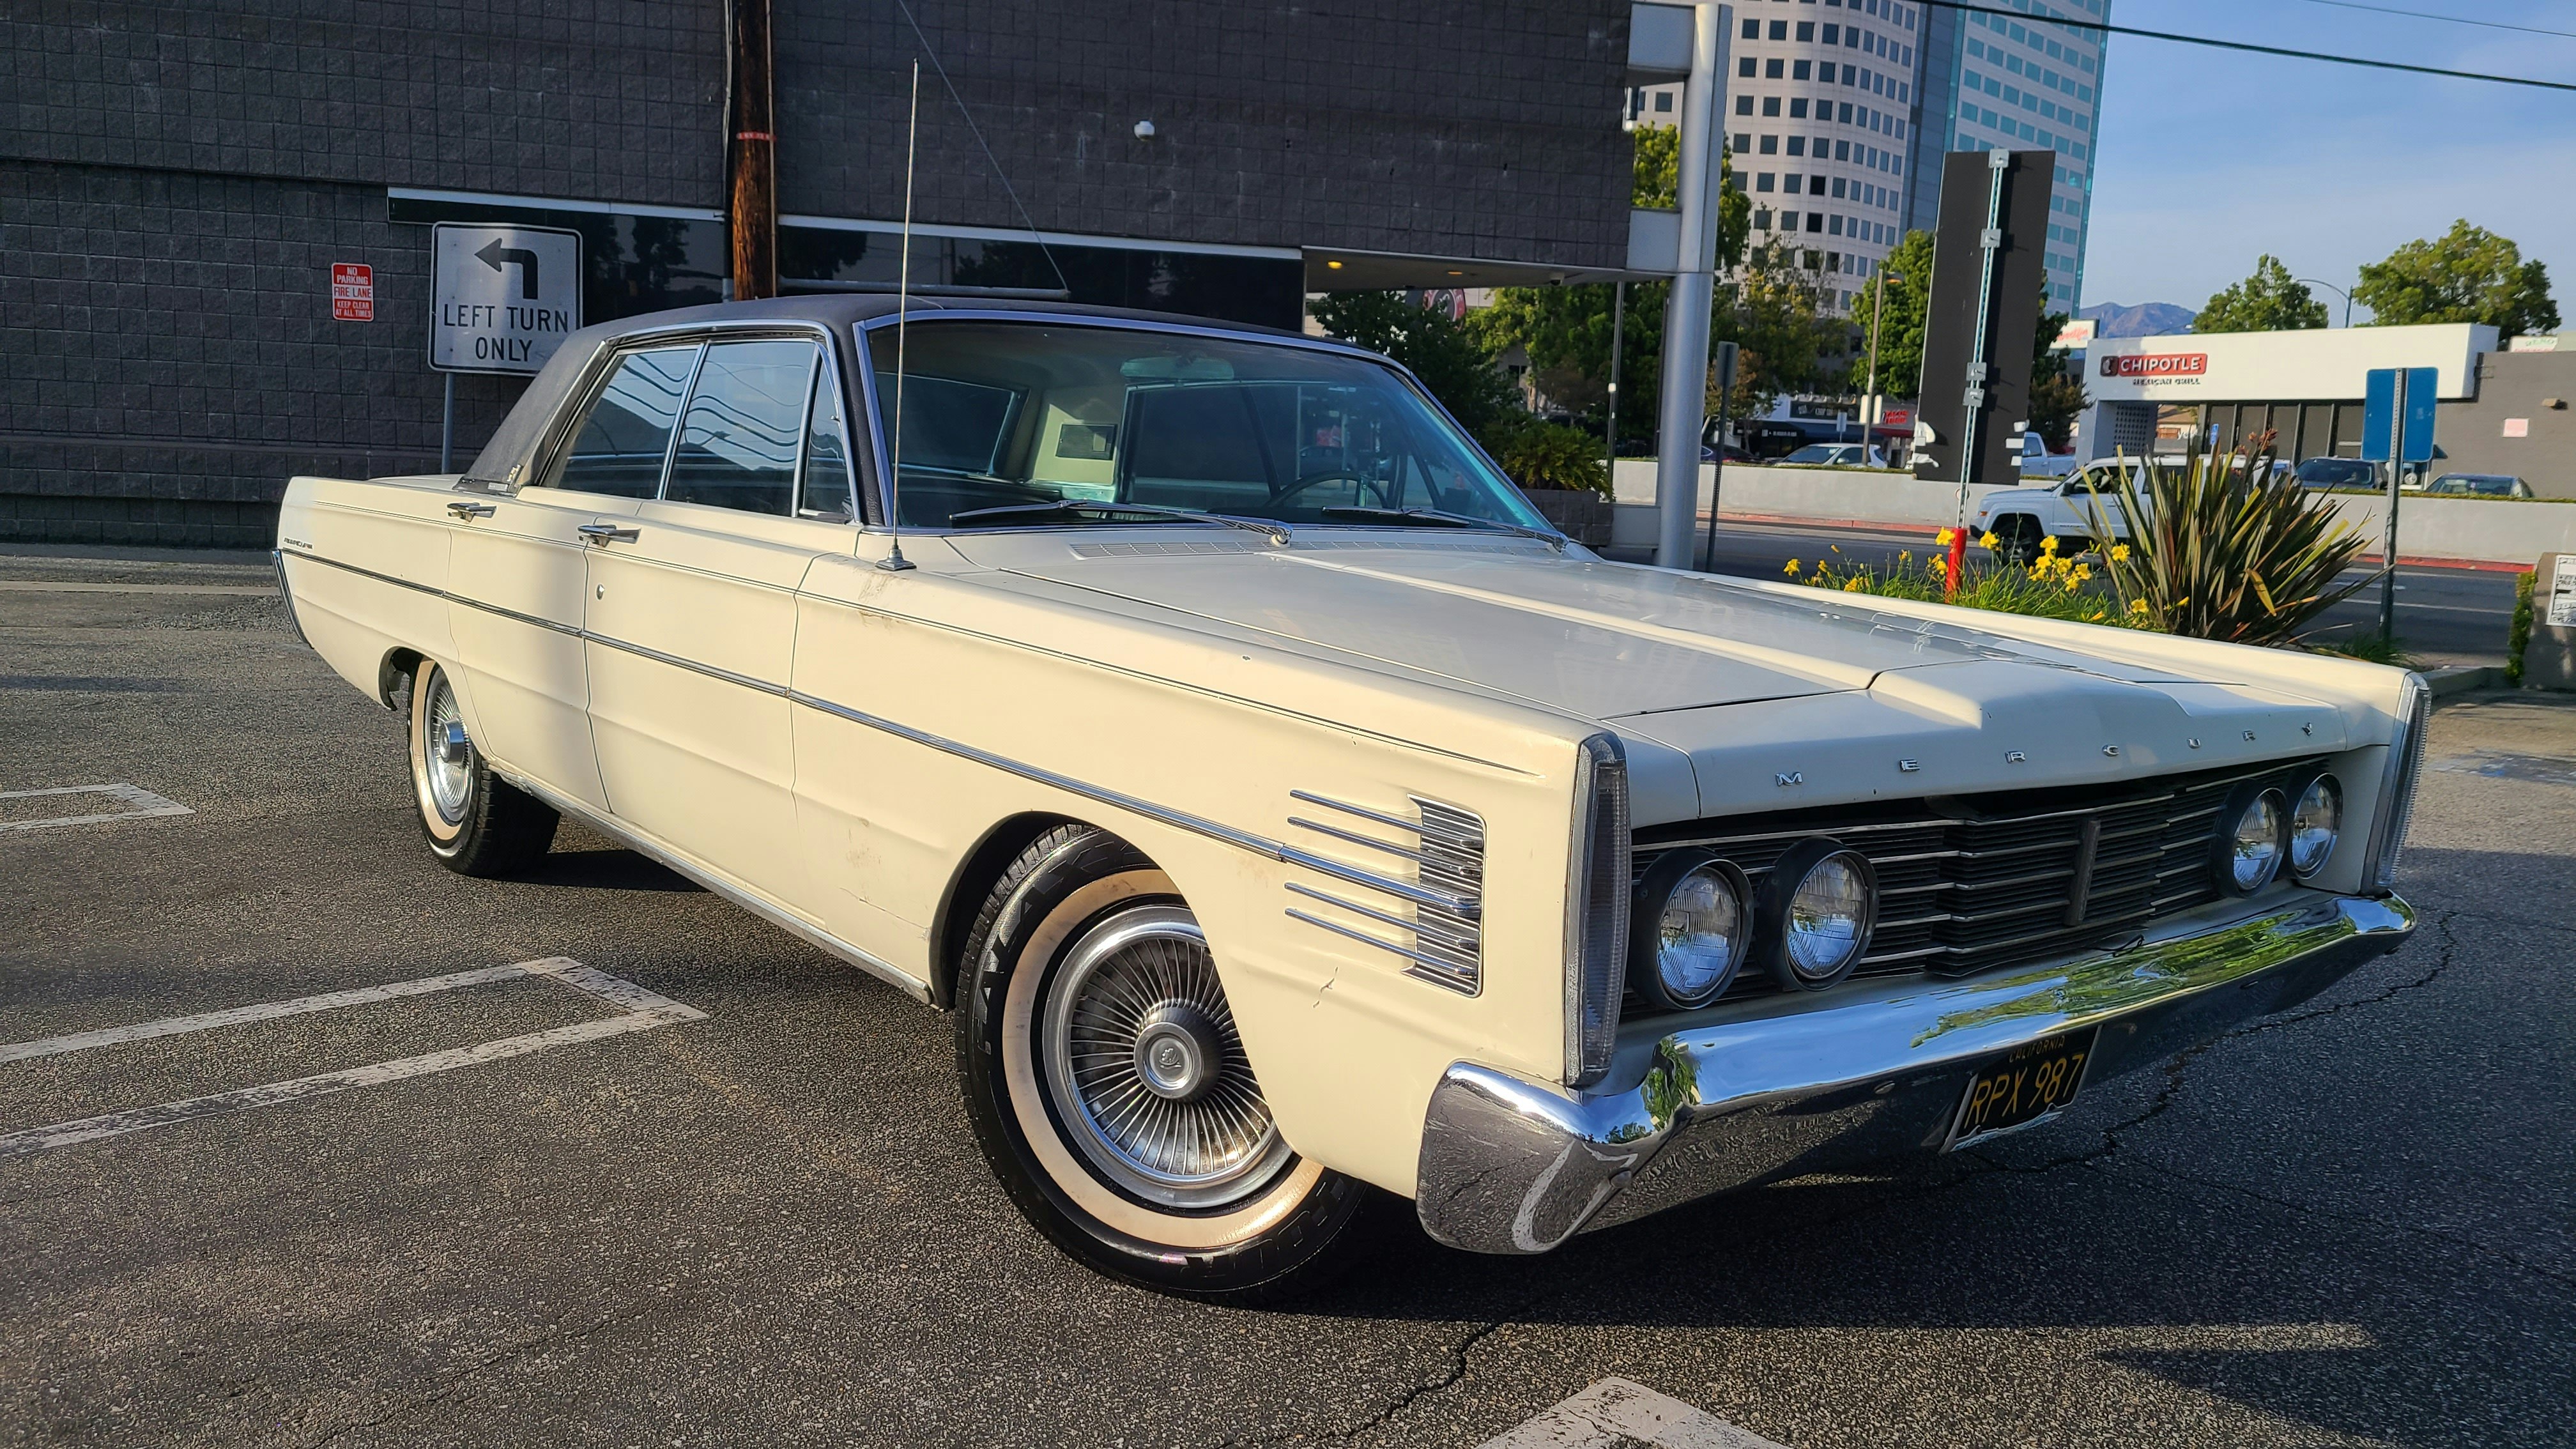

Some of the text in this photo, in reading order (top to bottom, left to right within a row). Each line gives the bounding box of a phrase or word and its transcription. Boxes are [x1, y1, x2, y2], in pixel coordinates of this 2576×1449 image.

[337, 275, 368, 284] PARKING
[347, 266, 357, 275] NO
[334, 286, 371, 298] FIRE LANE
[335, 308, 372, 318] AT ALL TIMES
[443, 303, 568, 333] LEFT TURN
[475, 337, 533, 362] ONLY
[2120, 356, 2202, 372] CHIPOTLE
[1775, 722, 2315, 786] MERCURY
[2009, 1035, 2065, 1063] CALIFORNIA
[1964, 1053, 2085, 1129] RPX 987
